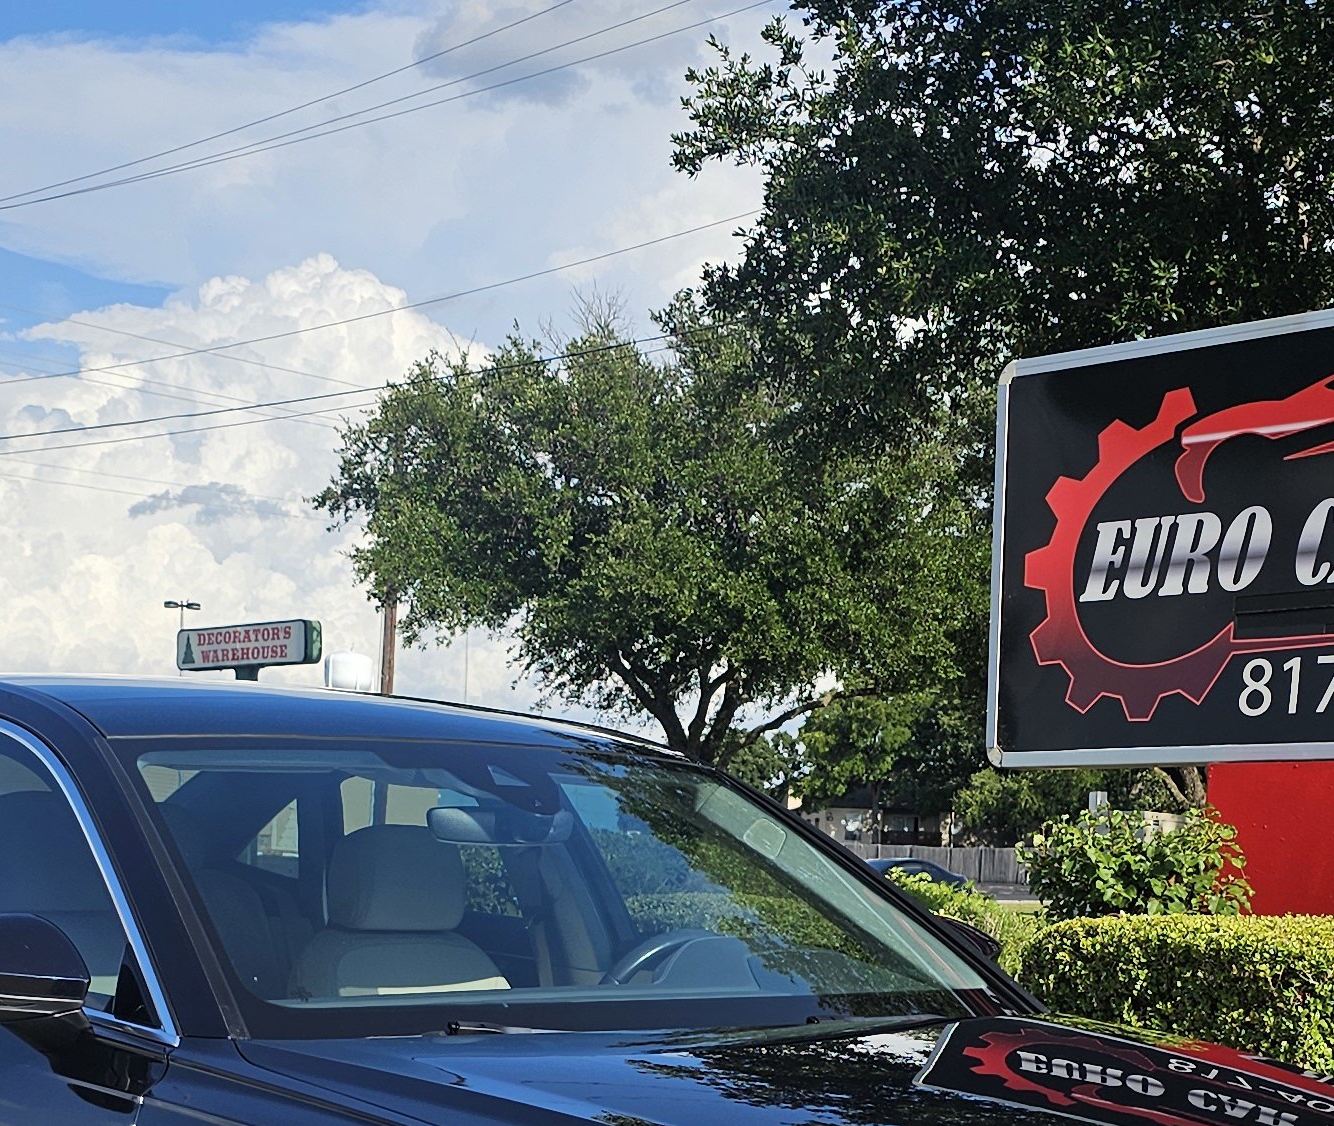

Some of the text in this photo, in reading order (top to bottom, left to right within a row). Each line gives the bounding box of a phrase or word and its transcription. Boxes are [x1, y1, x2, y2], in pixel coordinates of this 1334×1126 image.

[1078, 504, 1273, 603] EURO
[196, 625, 292, 647] DECORATOR'S
[200, 644, 288, 664] WAREHOUSE
